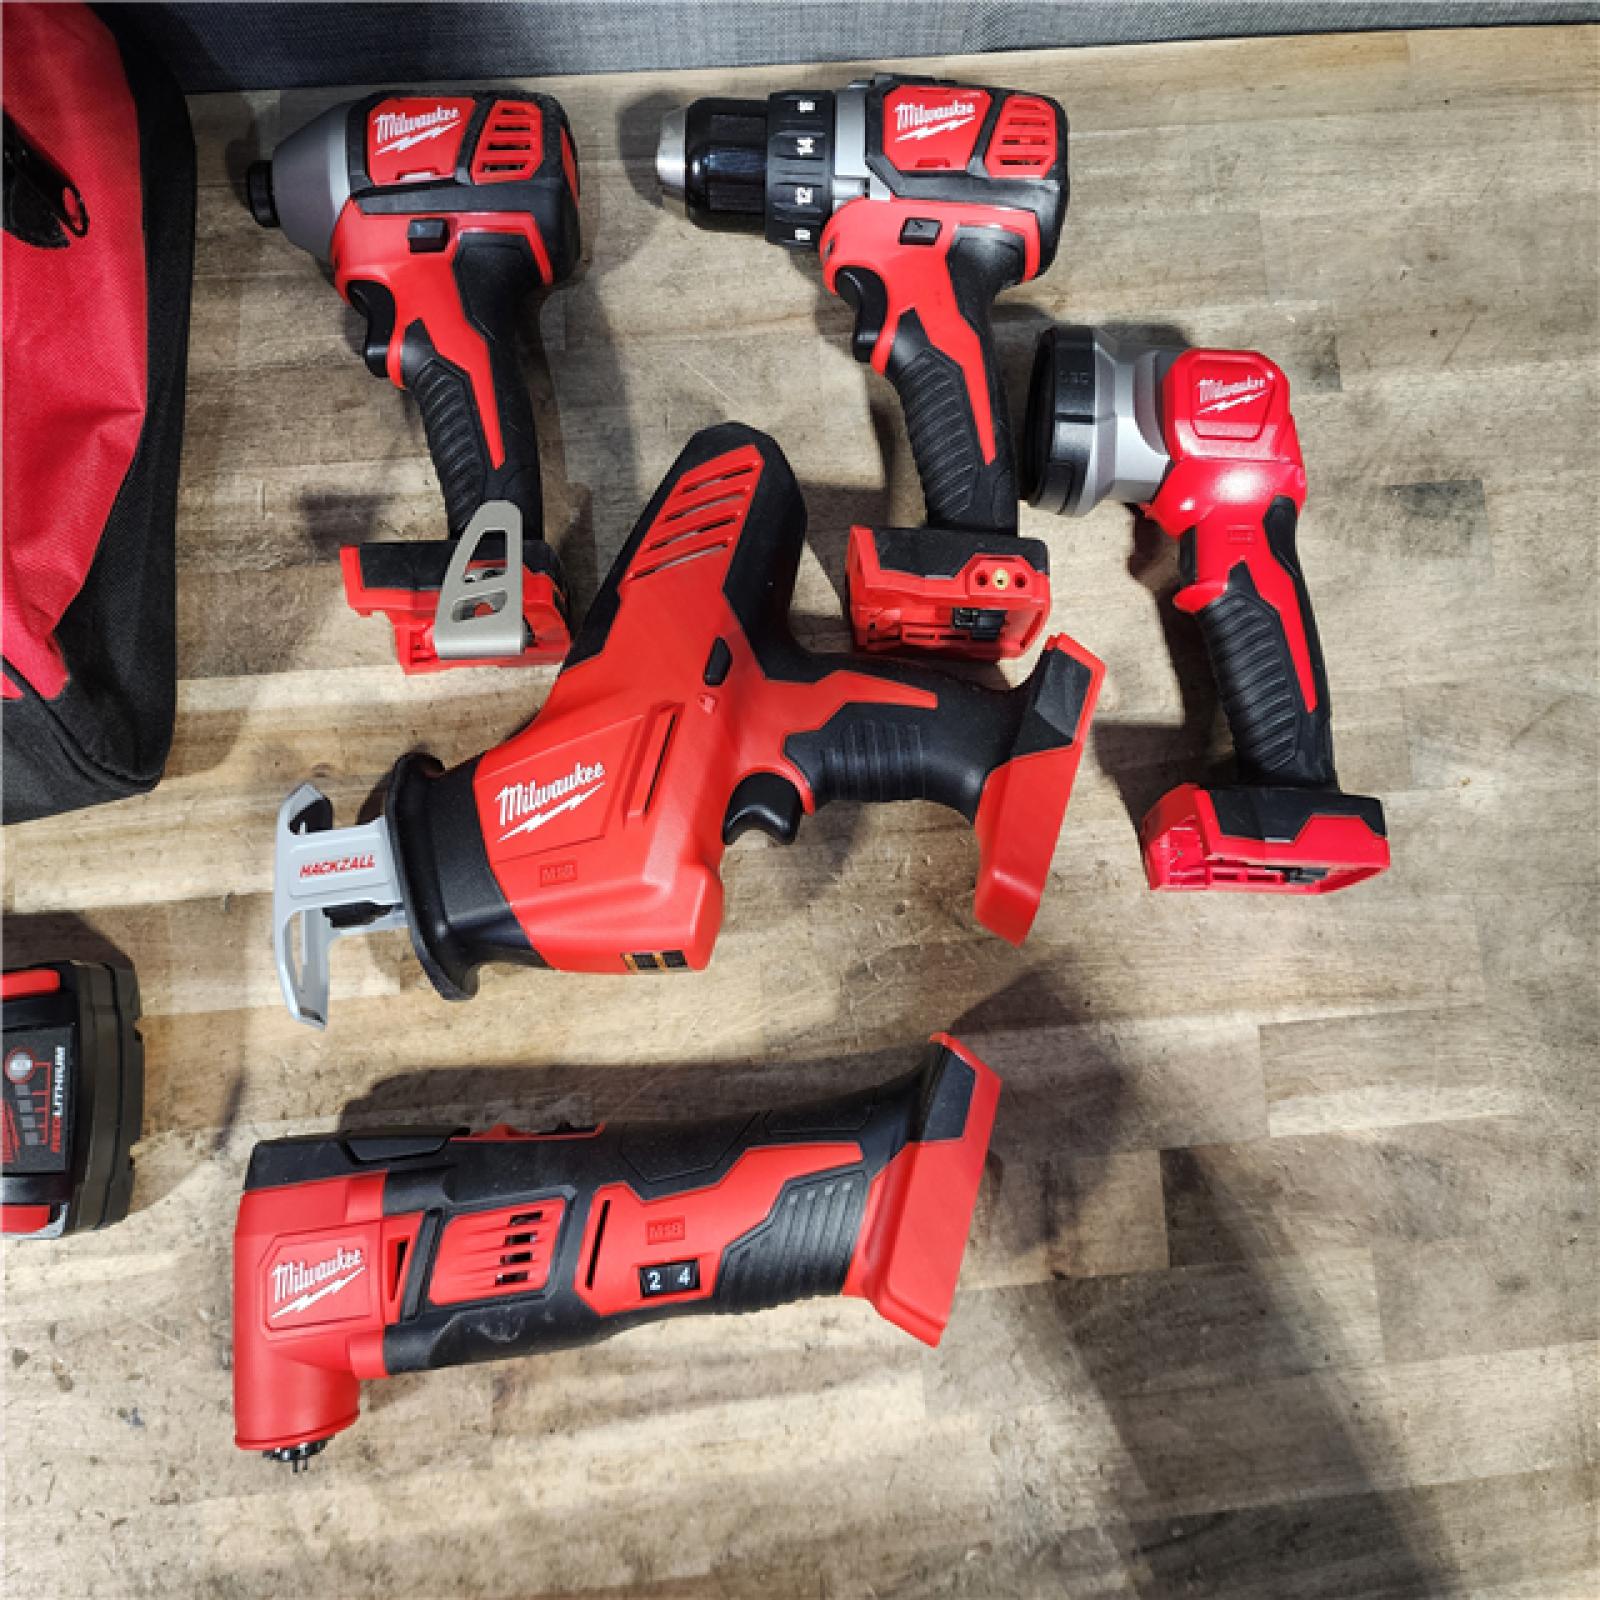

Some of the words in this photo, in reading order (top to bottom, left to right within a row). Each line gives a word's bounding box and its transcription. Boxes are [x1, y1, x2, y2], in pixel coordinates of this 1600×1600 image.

[374, 106, 460, 143] Milwaukee
[894, 100, 975, 131] Milwaukee
[1197, 375, 1265, 402] Milwaukee
[494, 762, 605, 826] Milwaukee
[299, 854, 376, 878] HACKZALL
[271, 1246, 362, 1304] Milwaukee
[648, 1271, 661, 1290] 2
[678, 1266, 690, 1285] 4
